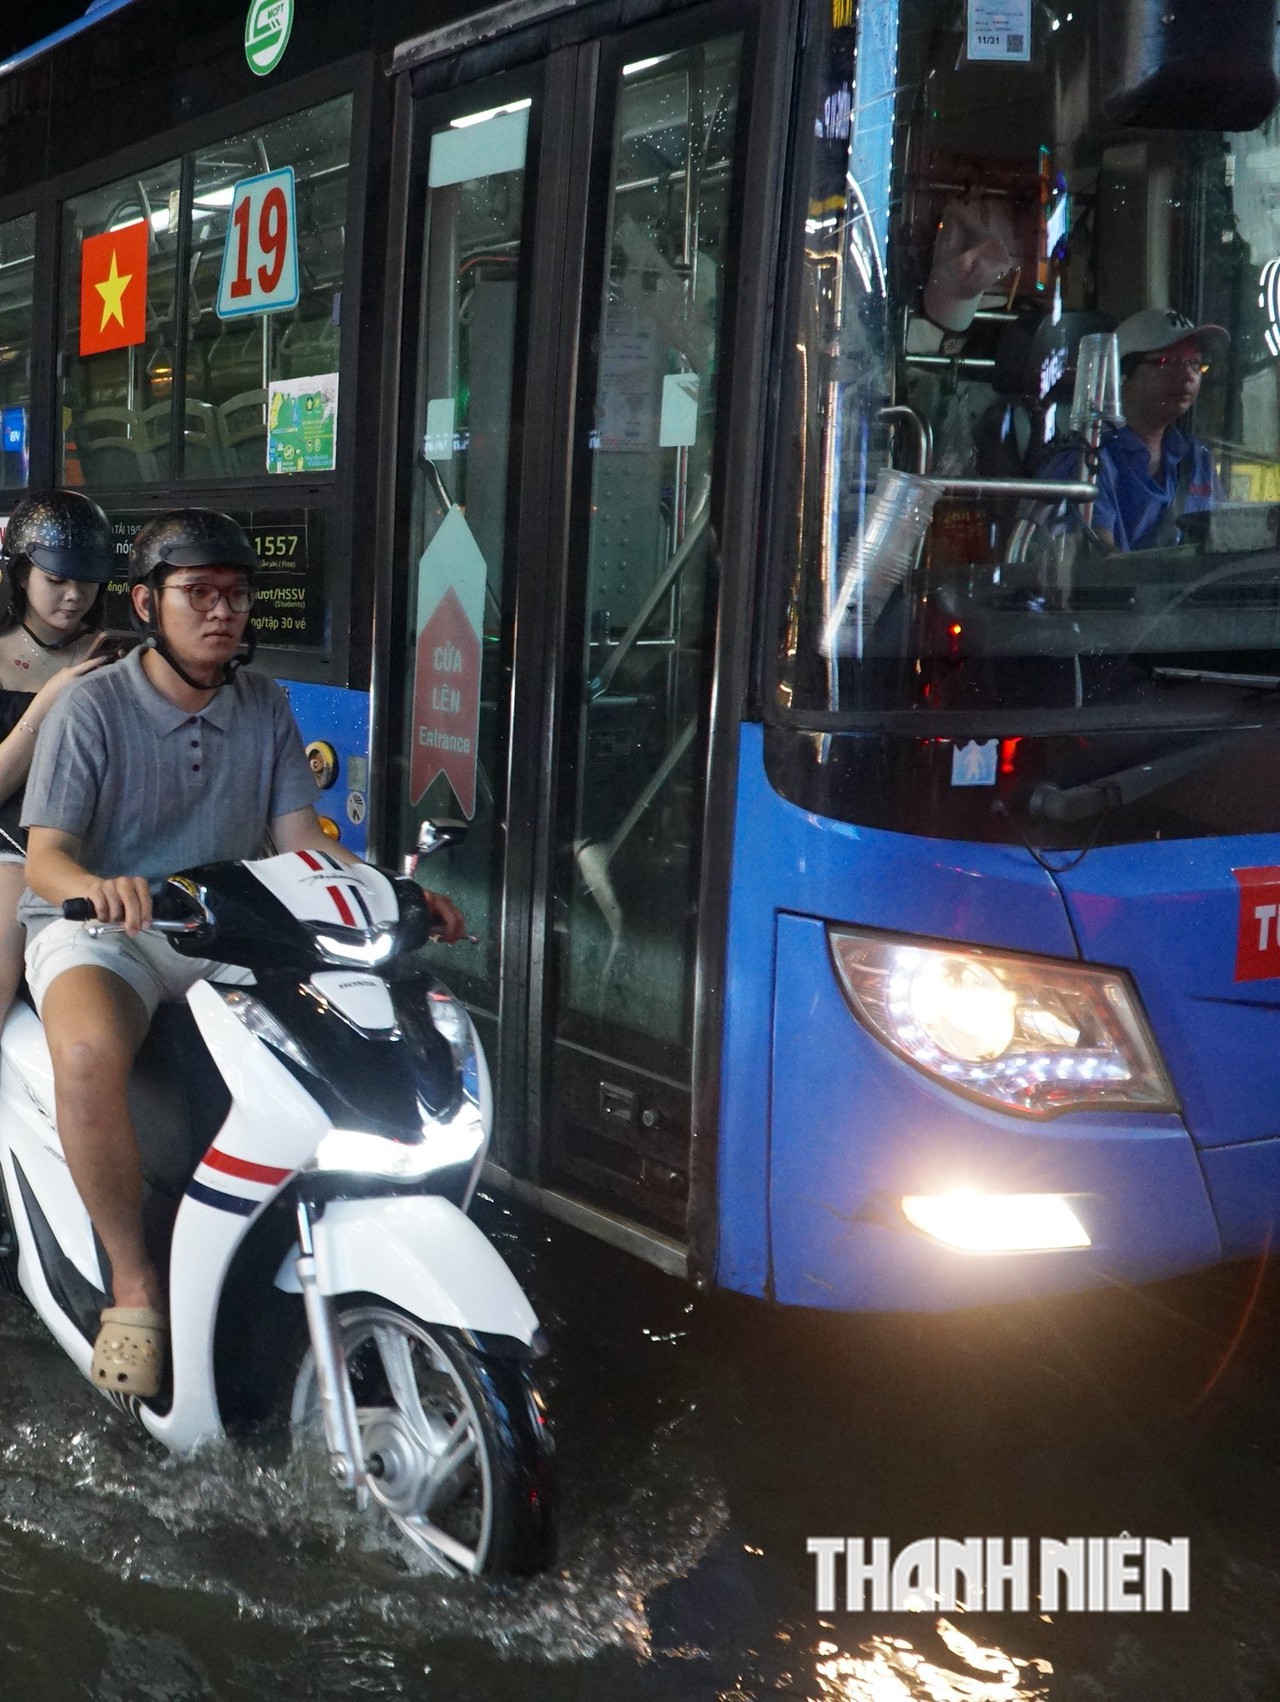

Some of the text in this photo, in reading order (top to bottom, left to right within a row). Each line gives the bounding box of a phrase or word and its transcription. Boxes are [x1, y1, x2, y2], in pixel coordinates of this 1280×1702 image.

[977, 36, 1000, 45] 11/31
[230, 187, 288, 299] 19
[254, 535, 298, 556] 1557
[281, 617, 293, 629] 30
[294, 616, 306, 629] vé
[433, 641, 463, 673] CỬA
[431, 683, 461, 714] LÊN
[419, 726, 470, 754] Entrance
